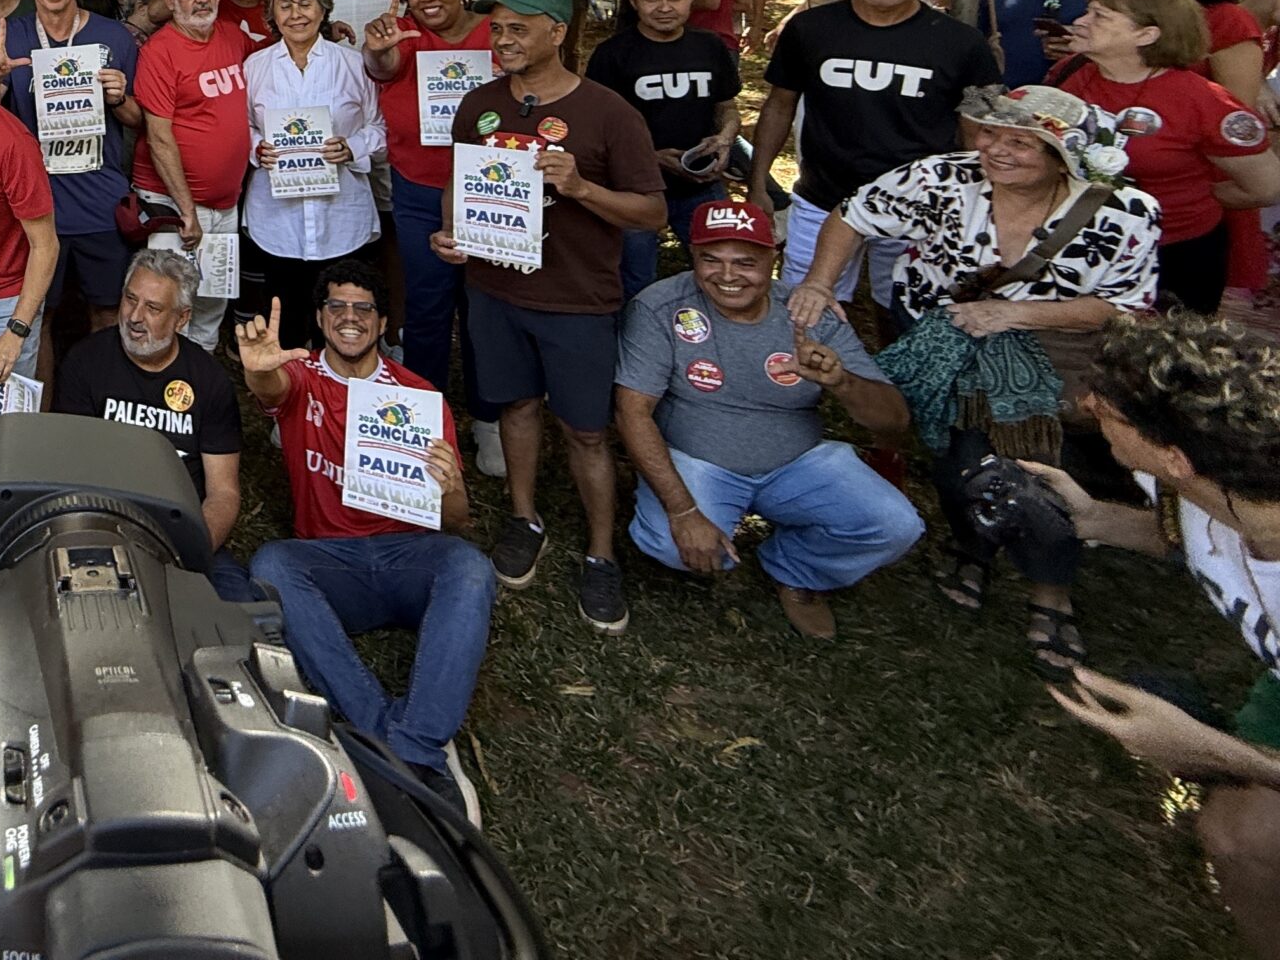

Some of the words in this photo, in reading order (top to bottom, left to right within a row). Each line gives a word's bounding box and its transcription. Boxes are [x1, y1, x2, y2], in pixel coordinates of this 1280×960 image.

[43, 77, 93, 88] CONCLAT
[199, 64, 245, 97] CUT
[635, 72, 712, 100] CUT
[820, 58, 933, 98] CUT
[46, 99, 93, 112] PAUTA
[47, 138, 92, 156] 10241
[274, 136, 323, 146] CONCLAT
[278, 157, 325, 169] PAUTA
[464, 182, 530, 199] CONCLAT
[466, 208, 527, 229] PAUTA
[706, 207, 750, 227] LULA
[104, 397, 194, 435] PALESTINA
[358, 414, 379, 424] 2026
[409, 425, 431, 435] 2030
[358, 423, 431, 448] CONCLAT
[306, 448, 345, 485] UNI
[359, 453, 426, 482] PAUTA
[95, 665, 136, 675] OPTICAL
[29, 724, 40, 758] CAMERA
[32, 775, 44, 808] MEDIA
[329, 810, 367, 828] ACCESS
